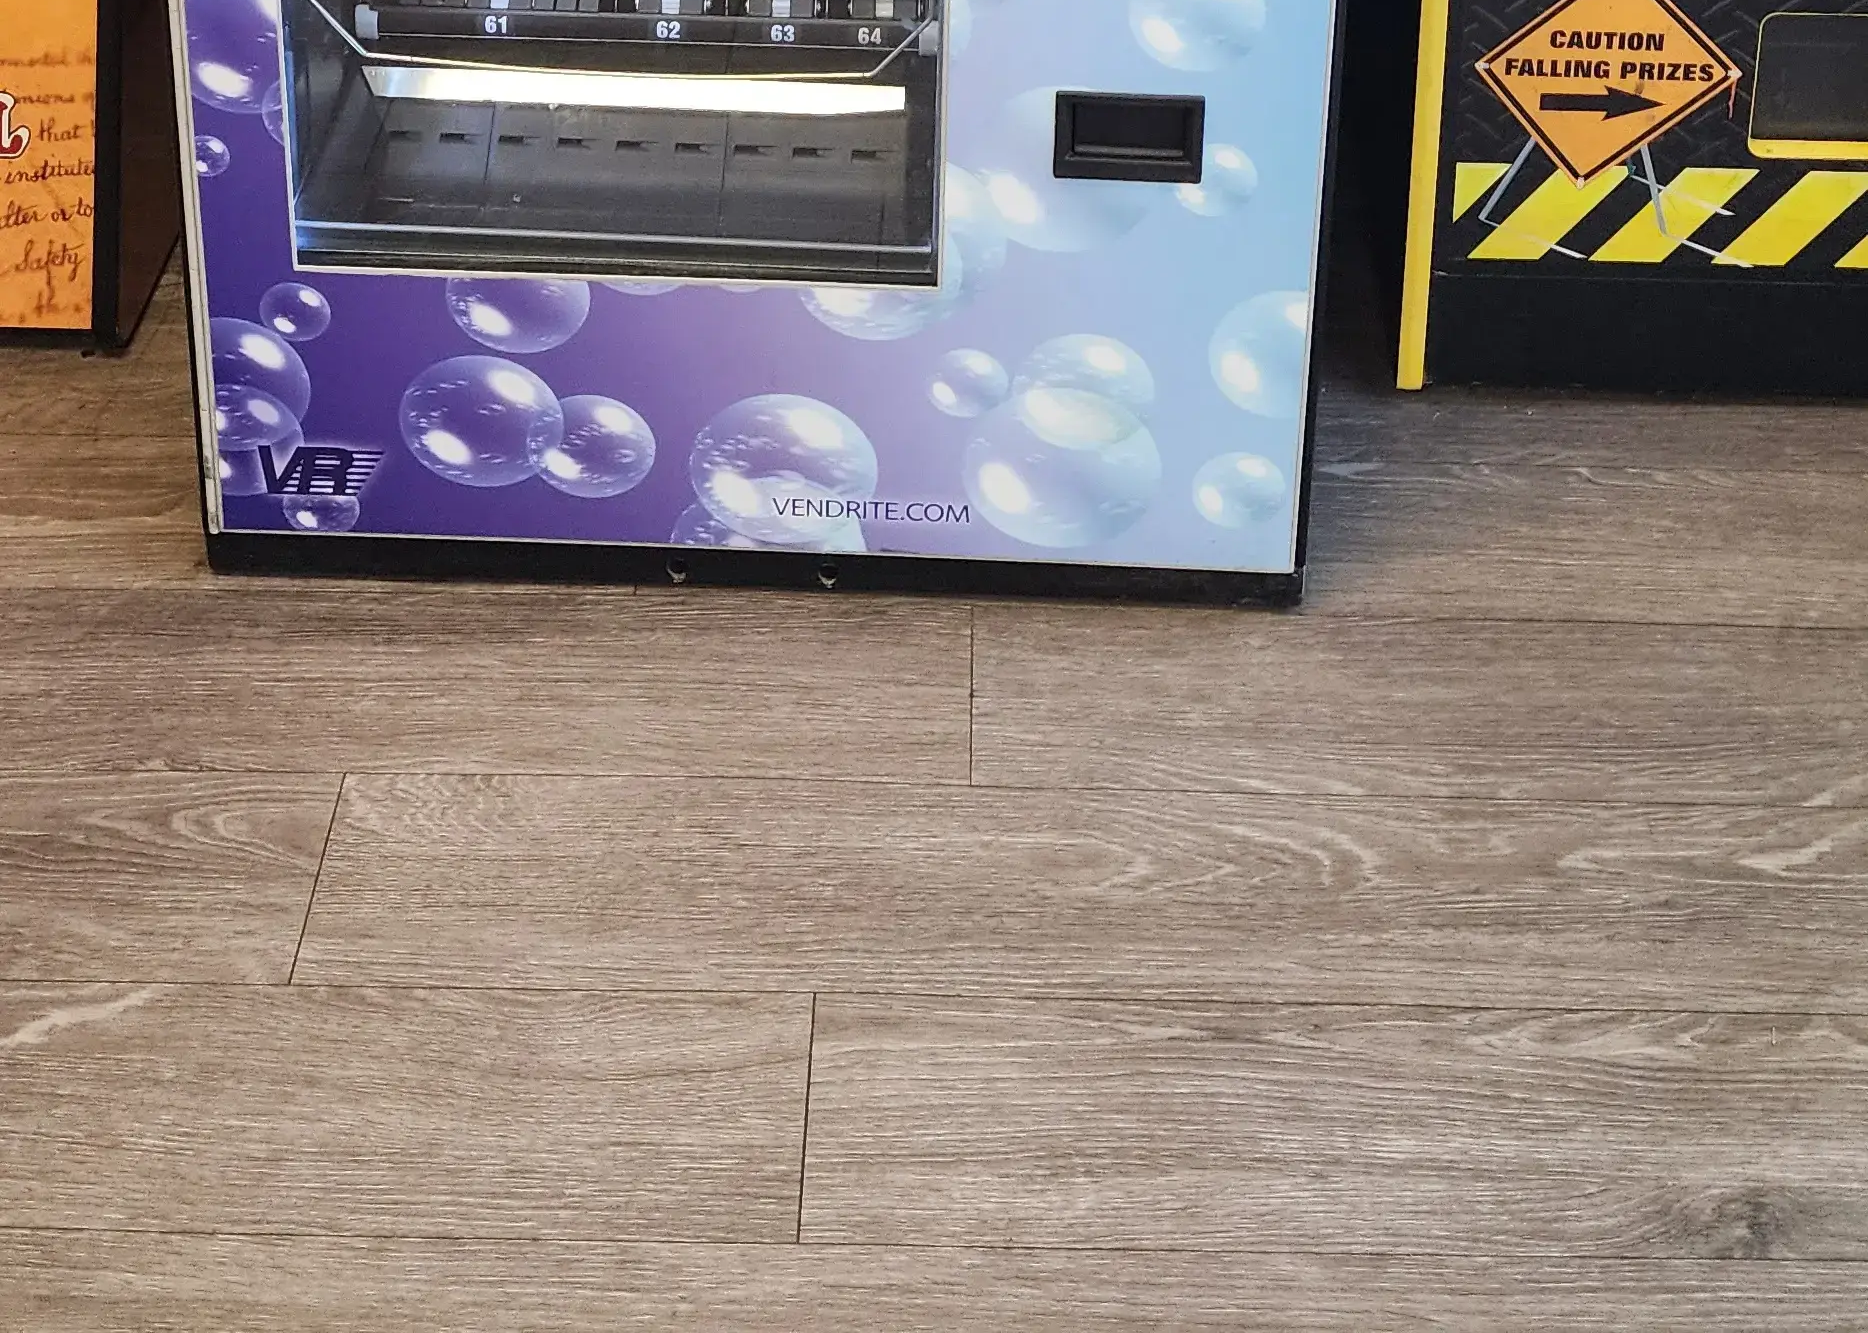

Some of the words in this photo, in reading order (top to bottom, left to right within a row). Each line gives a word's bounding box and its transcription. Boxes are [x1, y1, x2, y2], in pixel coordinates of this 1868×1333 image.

[484, 16, 507, 33] 61
[657, 21, 680, 38] 62
[771, 25, 794, 41] 63
[858, 28, 881, 43] 64
[1549, 29, 1665, 52] CAUTION
[1504, 58, 1611, 81] FALLING
[1619, 61, 1715, 83] PRIZES
[39, 116, 82, 143] that
[15, 238, 86, 286] Safety
[771, 495, 972, 525] VENDRITE.COM
